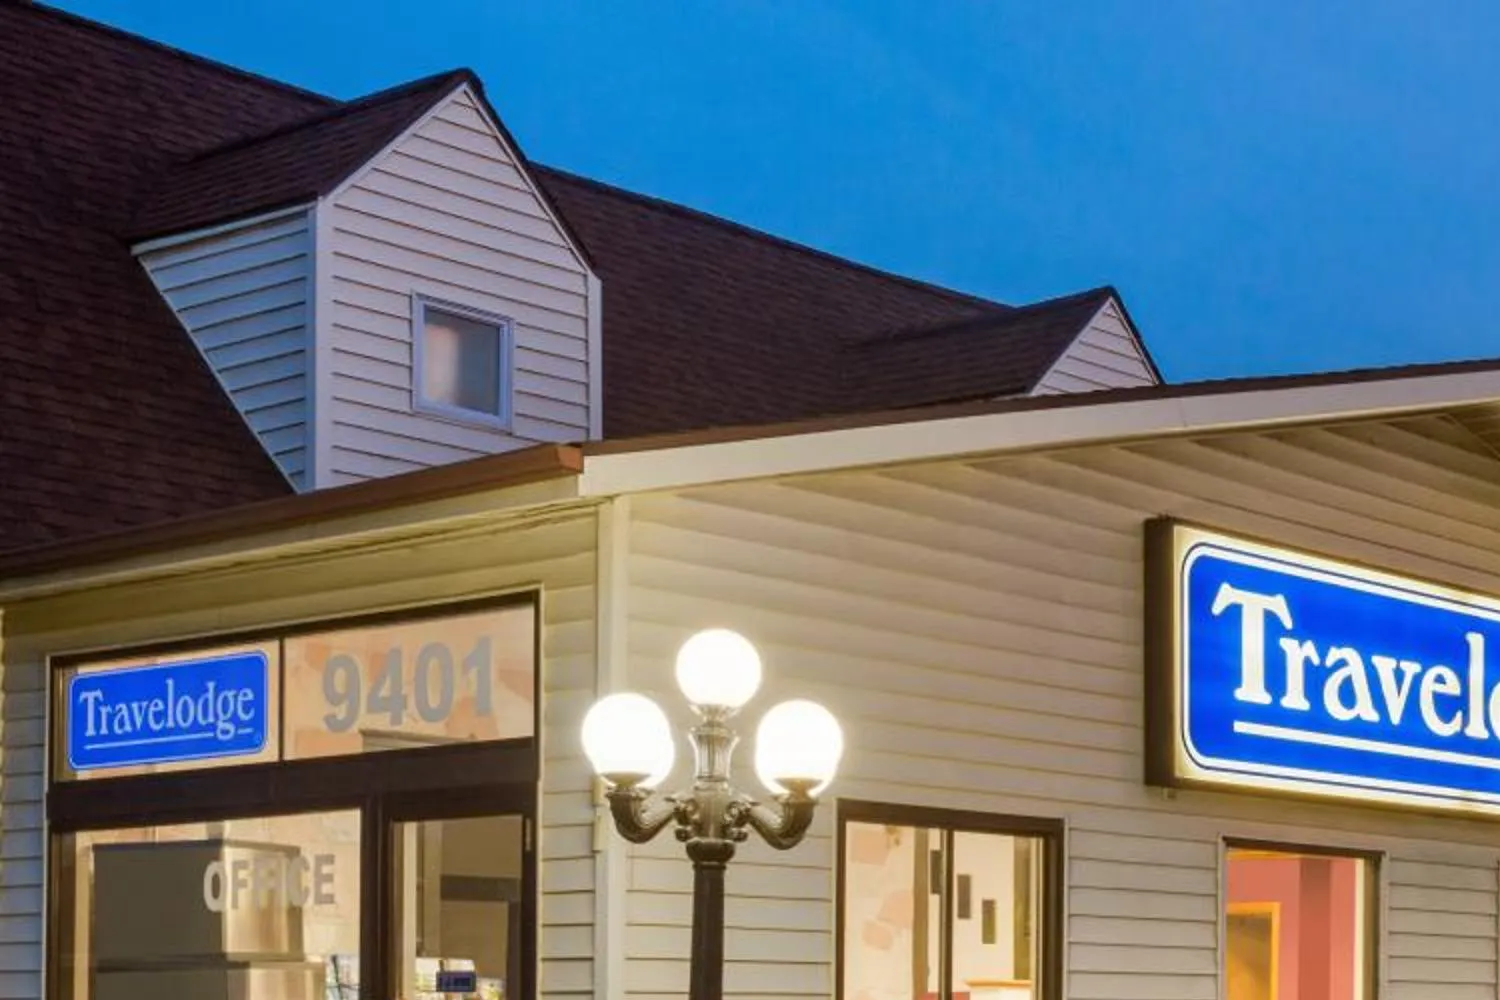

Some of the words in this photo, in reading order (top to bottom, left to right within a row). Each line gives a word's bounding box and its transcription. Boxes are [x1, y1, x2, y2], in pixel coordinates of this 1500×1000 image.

[79, 677, 255, 741] Travelodge
[322, 636, 495, 733] 9401
[203, 854, 336, 912] OFFICE
